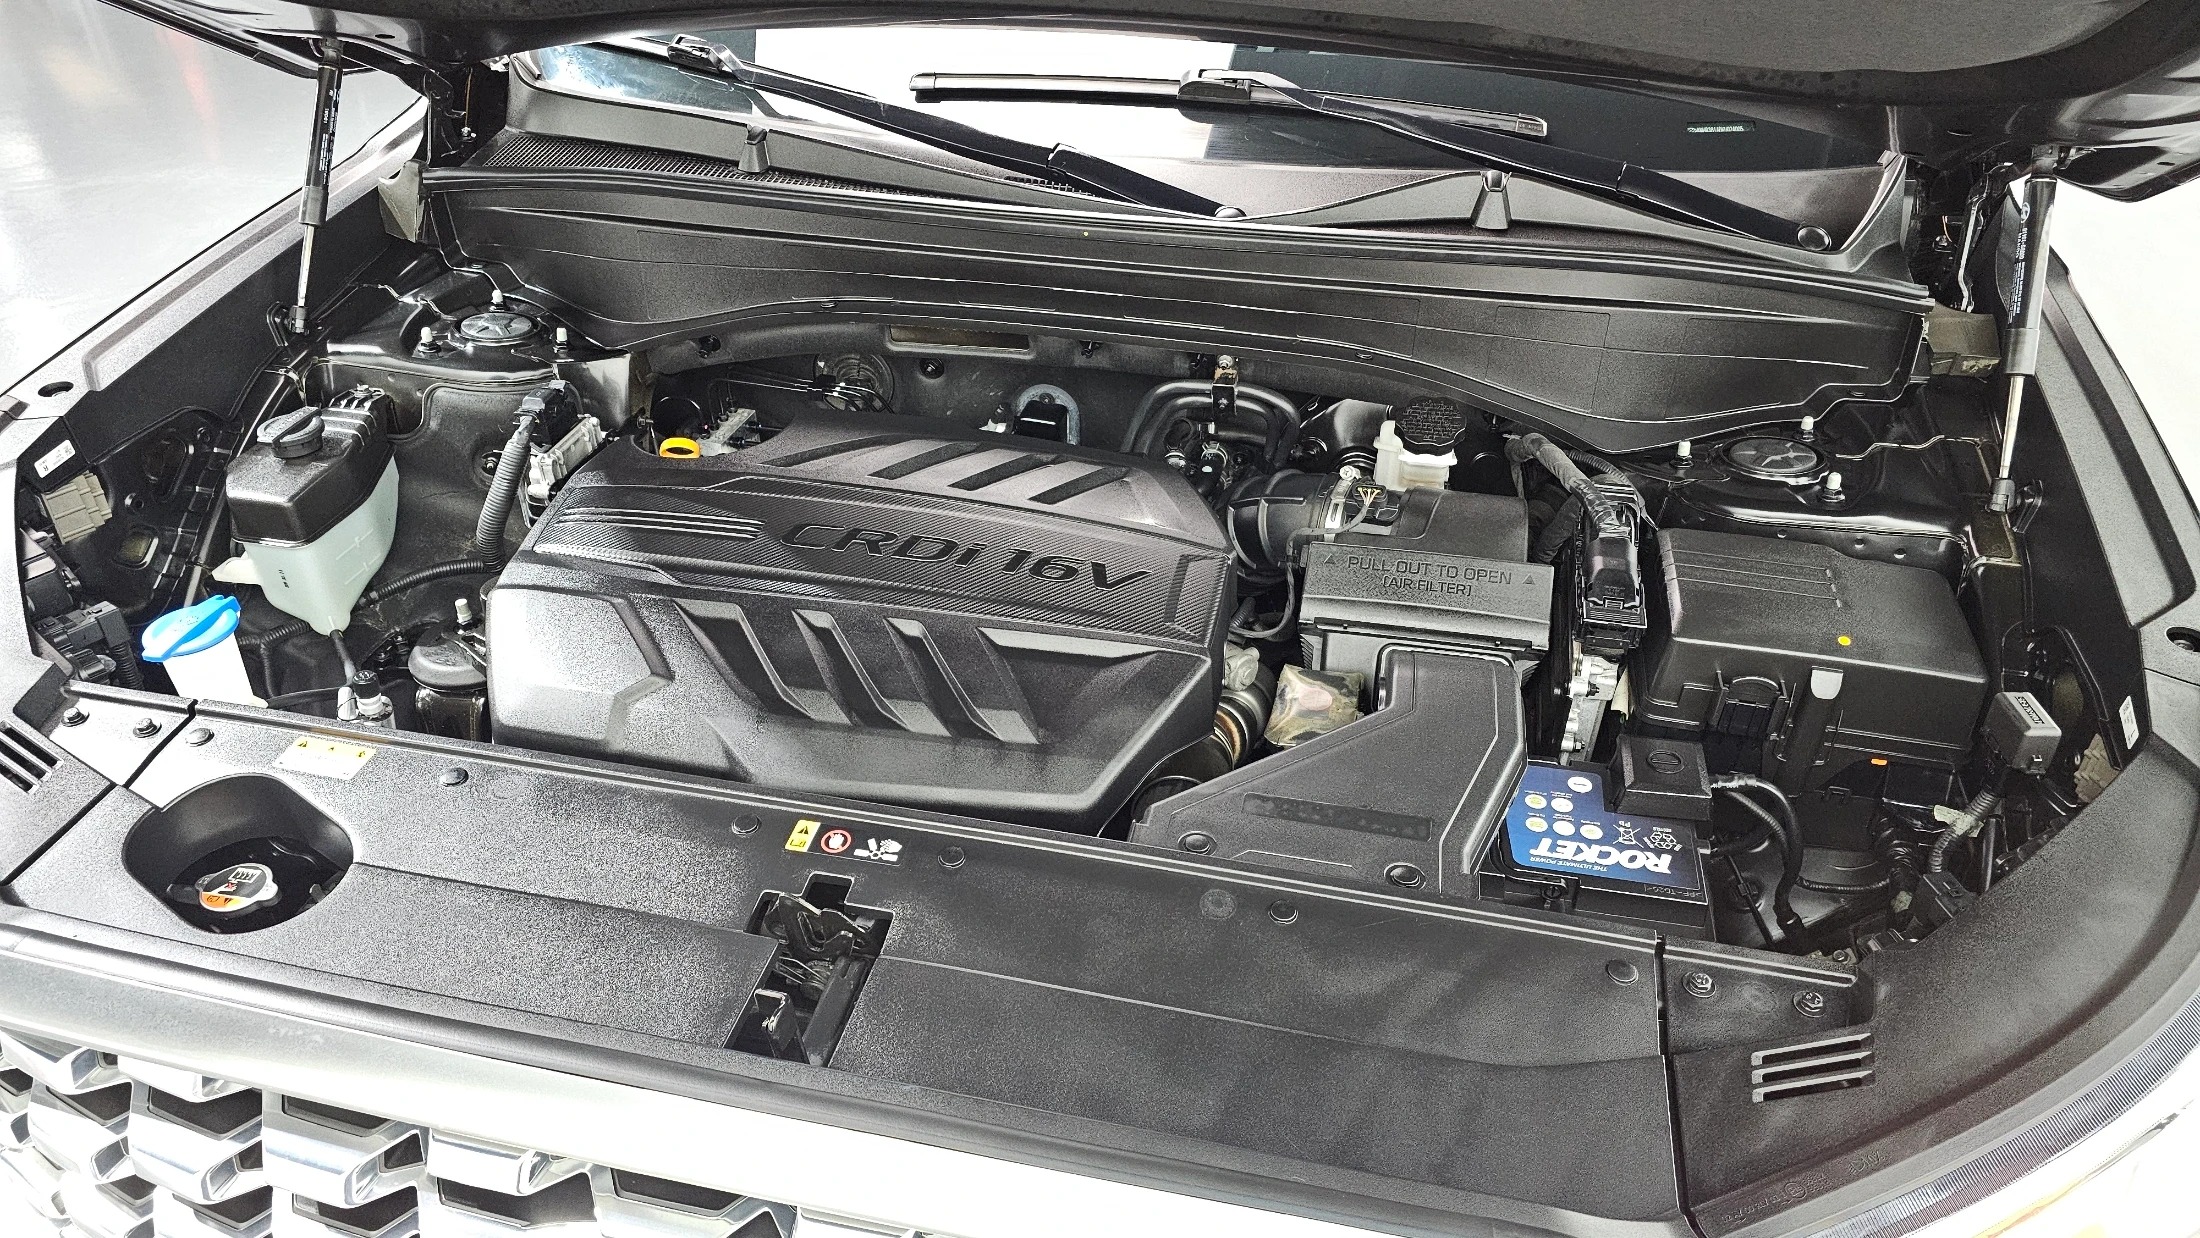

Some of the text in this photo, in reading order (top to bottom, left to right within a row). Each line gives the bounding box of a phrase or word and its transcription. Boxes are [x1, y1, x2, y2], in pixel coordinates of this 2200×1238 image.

[779, 524, 1153, 591] CRDi 16V
[1347, 555, 1513, 585] PULL OUT TO OPEN
[1529, 837, 1673, 875] ROCKET
[1529, 856, 1557, 867] POWER
[1557, 860, 1593, 871] ULTIMATE
